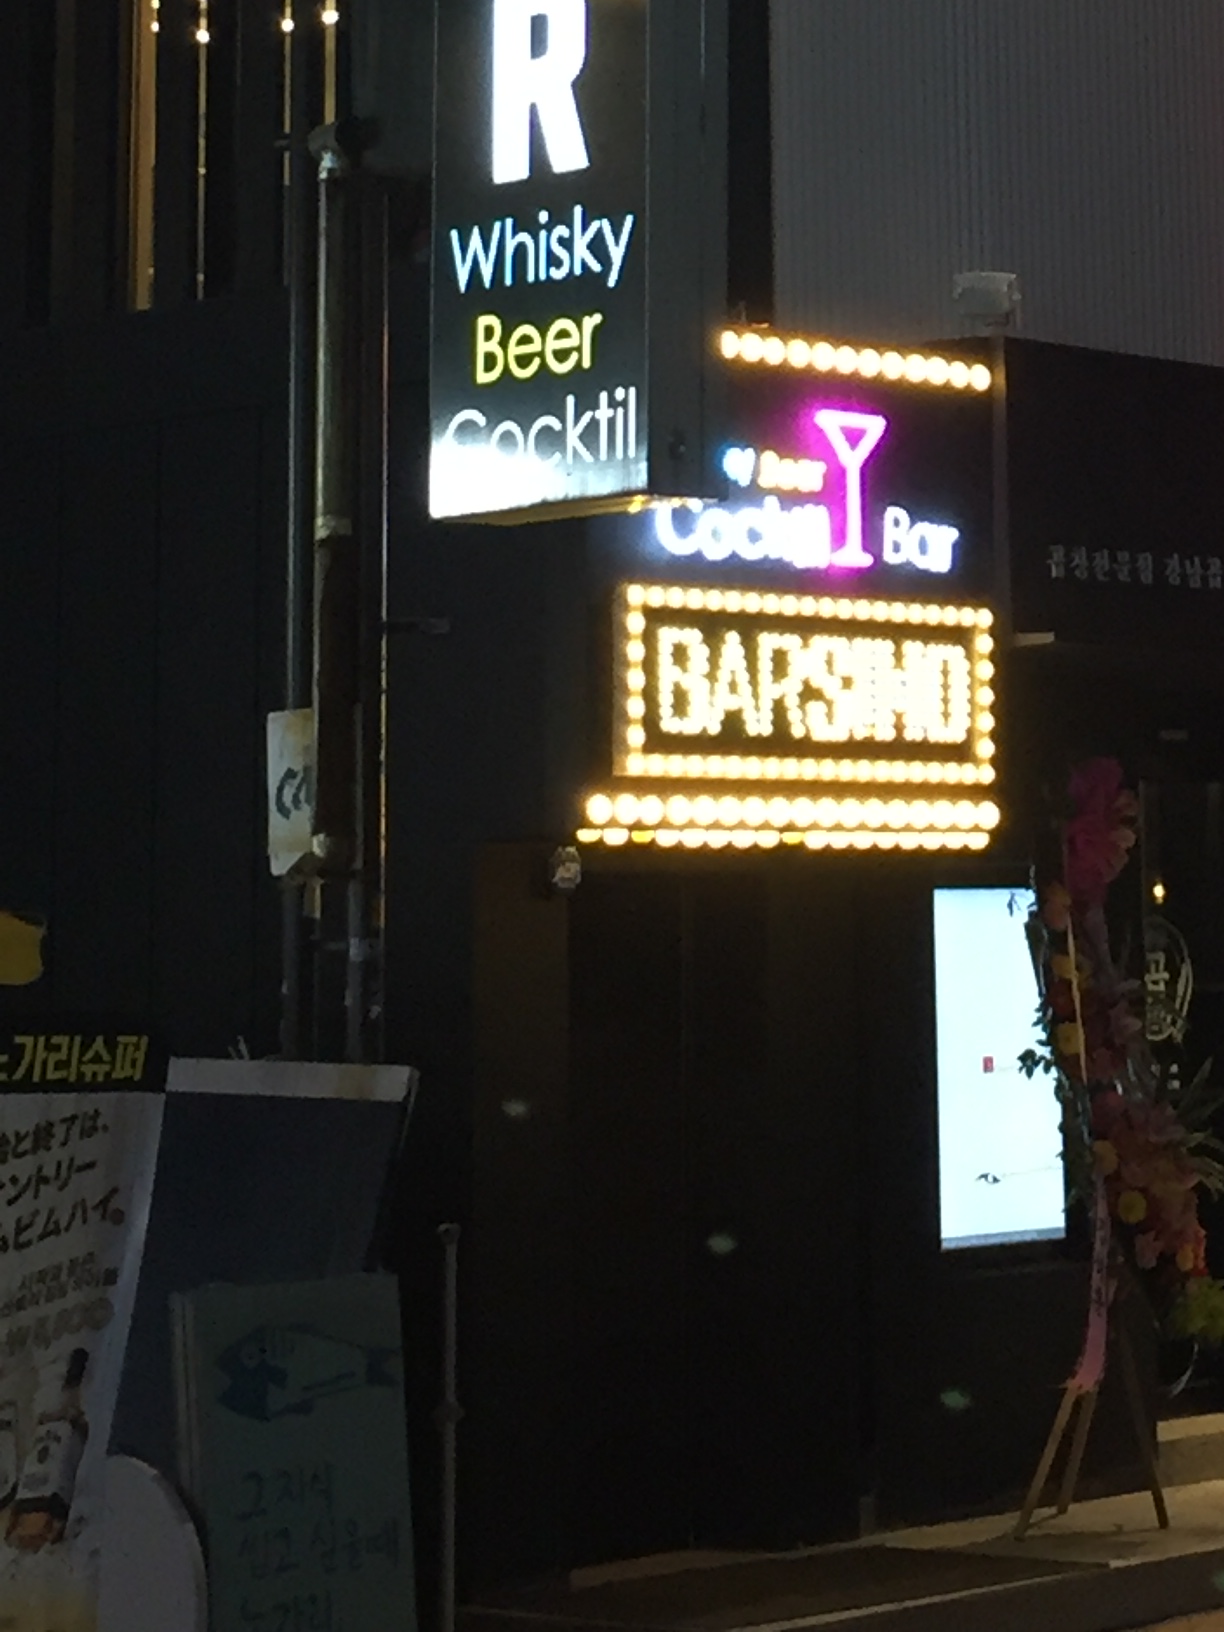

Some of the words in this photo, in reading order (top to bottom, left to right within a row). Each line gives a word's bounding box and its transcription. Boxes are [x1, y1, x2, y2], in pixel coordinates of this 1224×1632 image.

[450, 204, 634, 293] Whisky
[475, 312, 603, 385] Beer
[883, 505, 960, 573] Bar
[0, 1156, 98, 1207] ントリー
